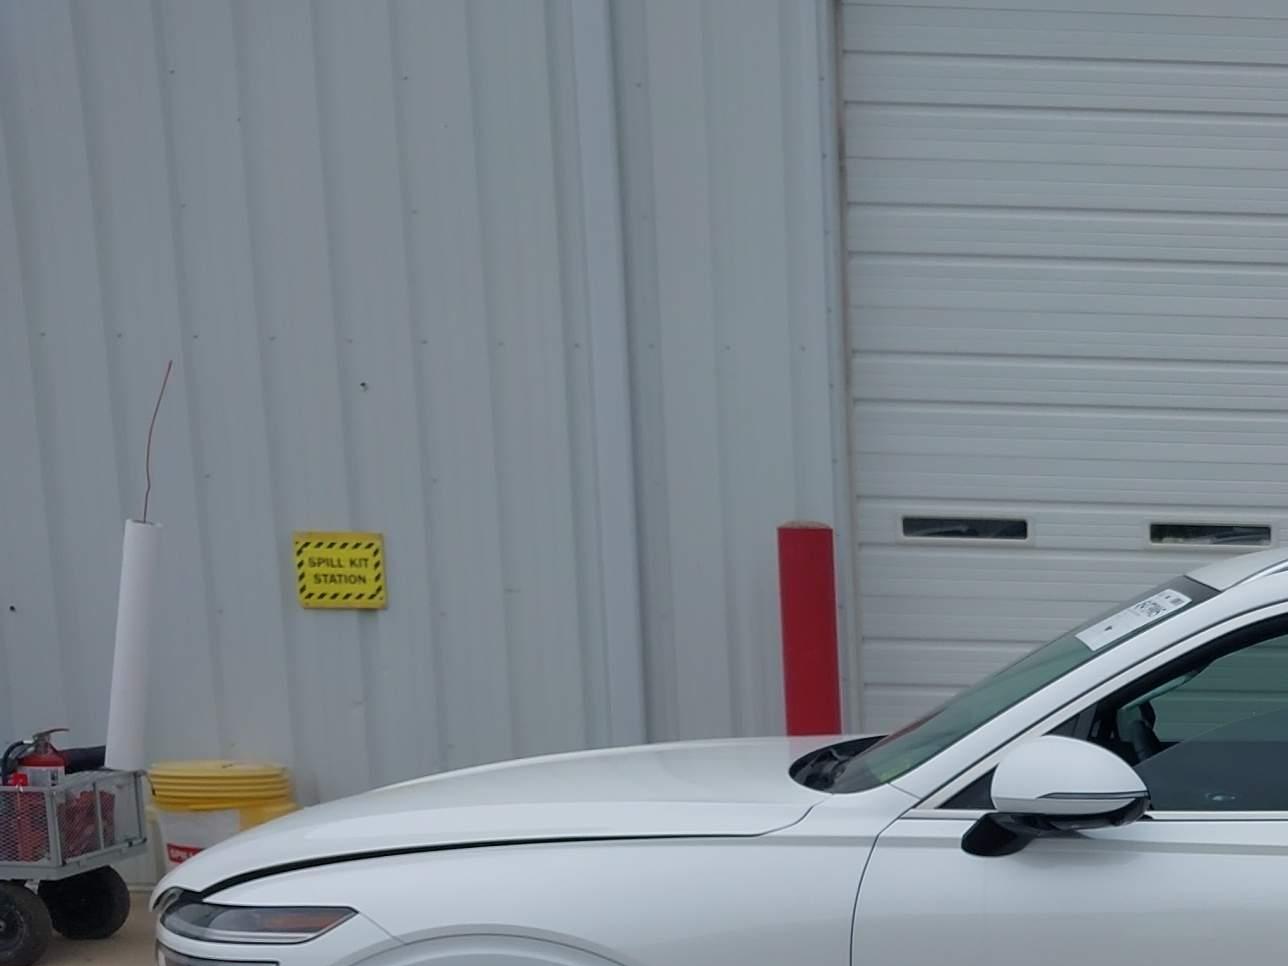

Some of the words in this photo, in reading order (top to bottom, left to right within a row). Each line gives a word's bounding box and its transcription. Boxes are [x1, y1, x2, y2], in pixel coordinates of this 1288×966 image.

[308, 557, 345, 568] SPILL
[350, 558, 369, 568] KIT
[313, 573, 367, 584] STATION
